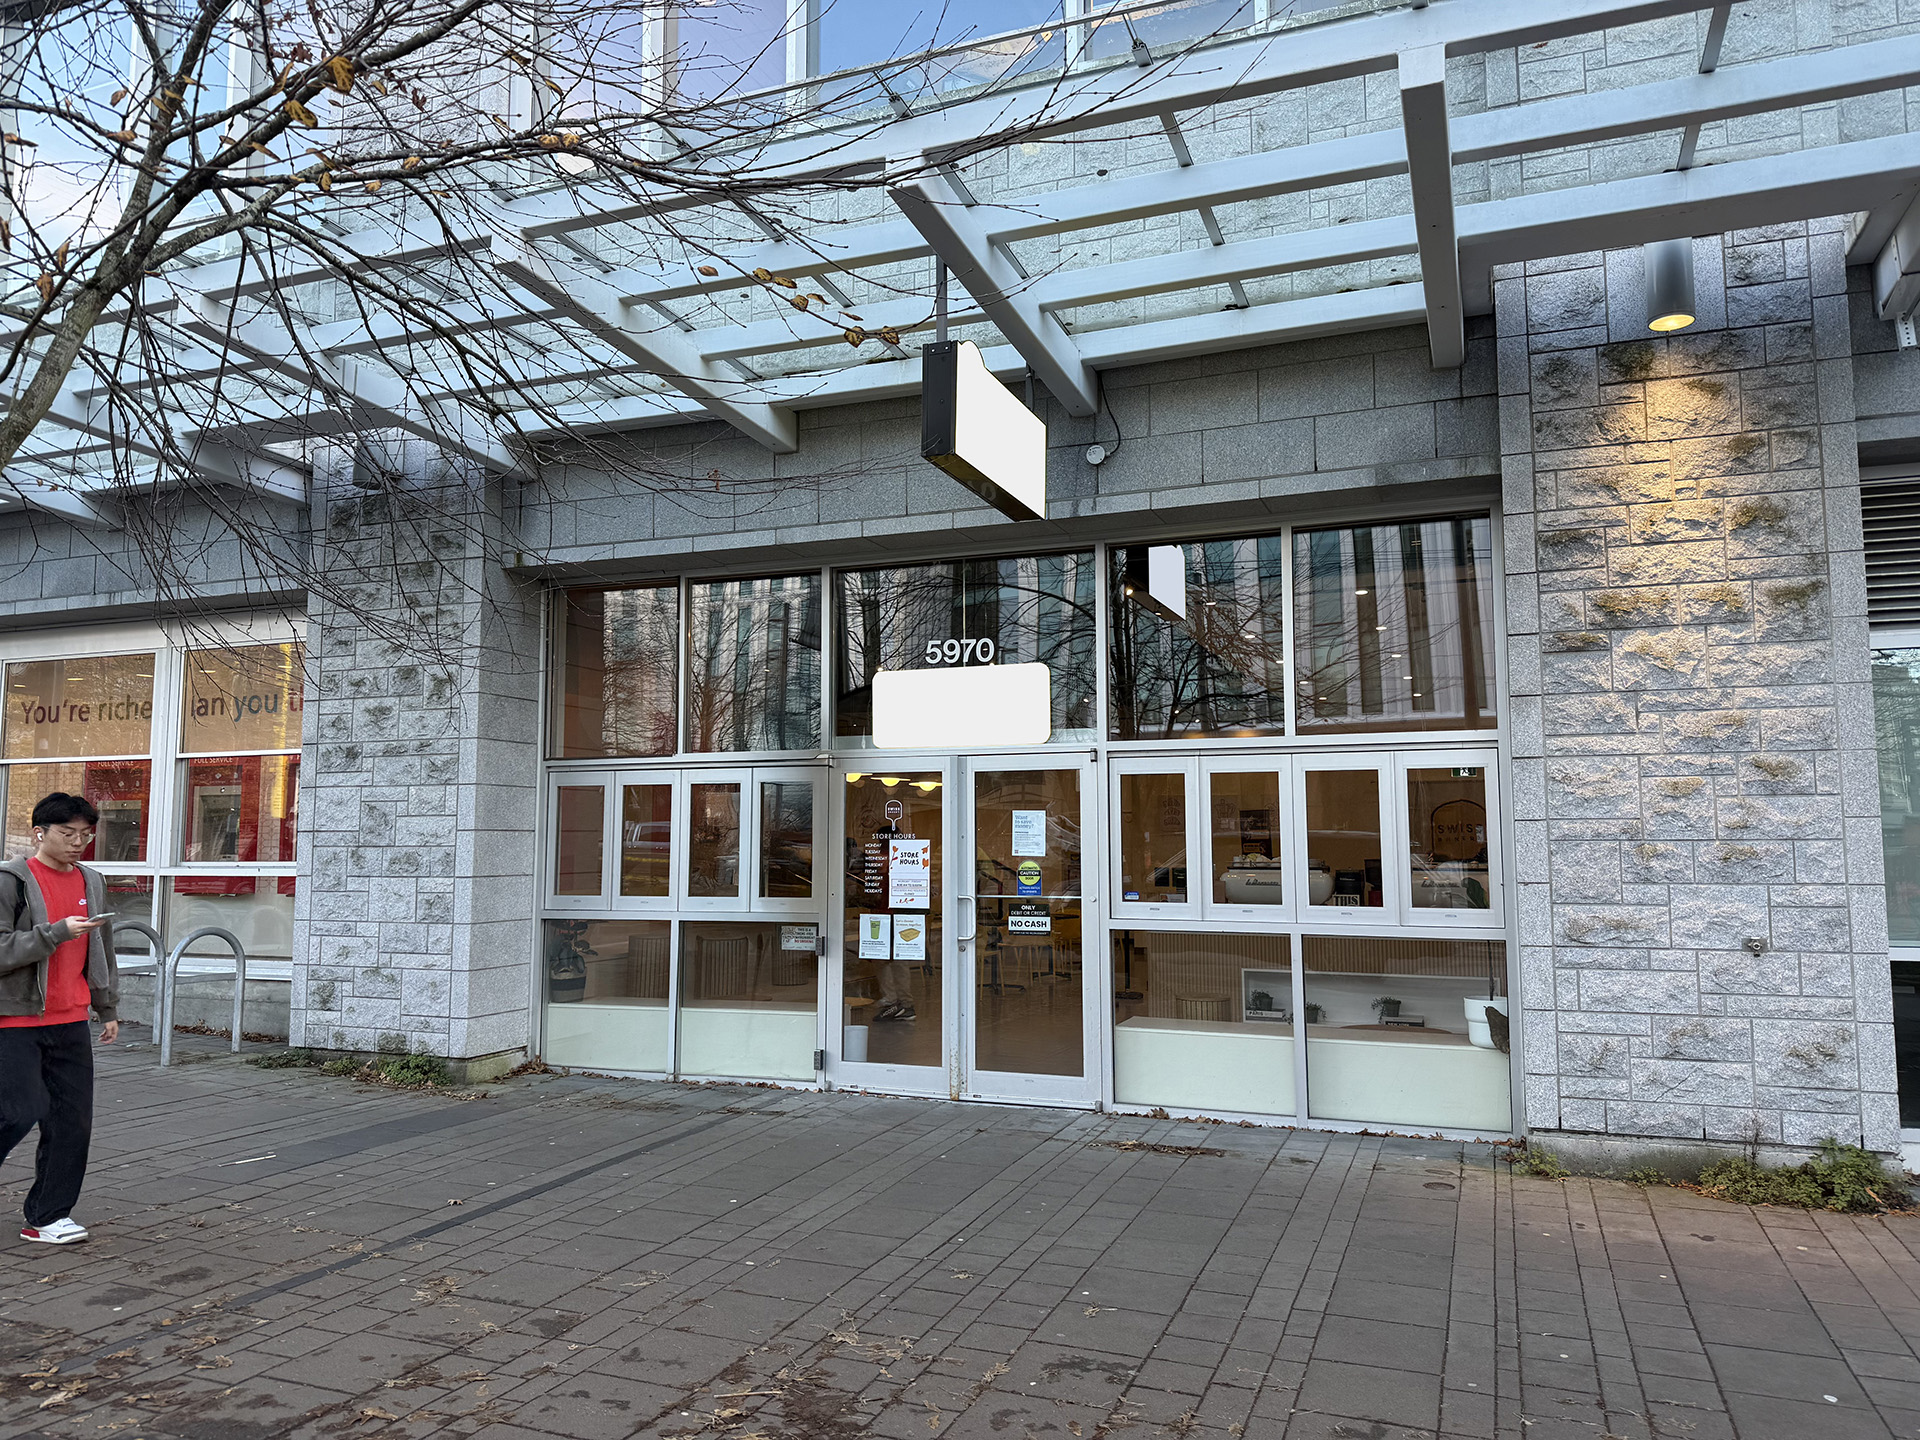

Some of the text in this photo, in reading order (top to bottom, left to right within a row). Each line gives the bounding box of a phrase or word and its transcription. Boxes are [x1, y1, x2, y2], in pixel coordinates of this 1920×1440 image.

[925, 638, 995, 664] 5970
[21, 699, 91, 724] You're
[98, 695, 152, 720] riche
[234, 693, 278, 722] you
[900, 851, 919, 859] STORE
[1334, 895, 1359, 906] THIS
[1010, 920, 1047, 928] NO CASH
